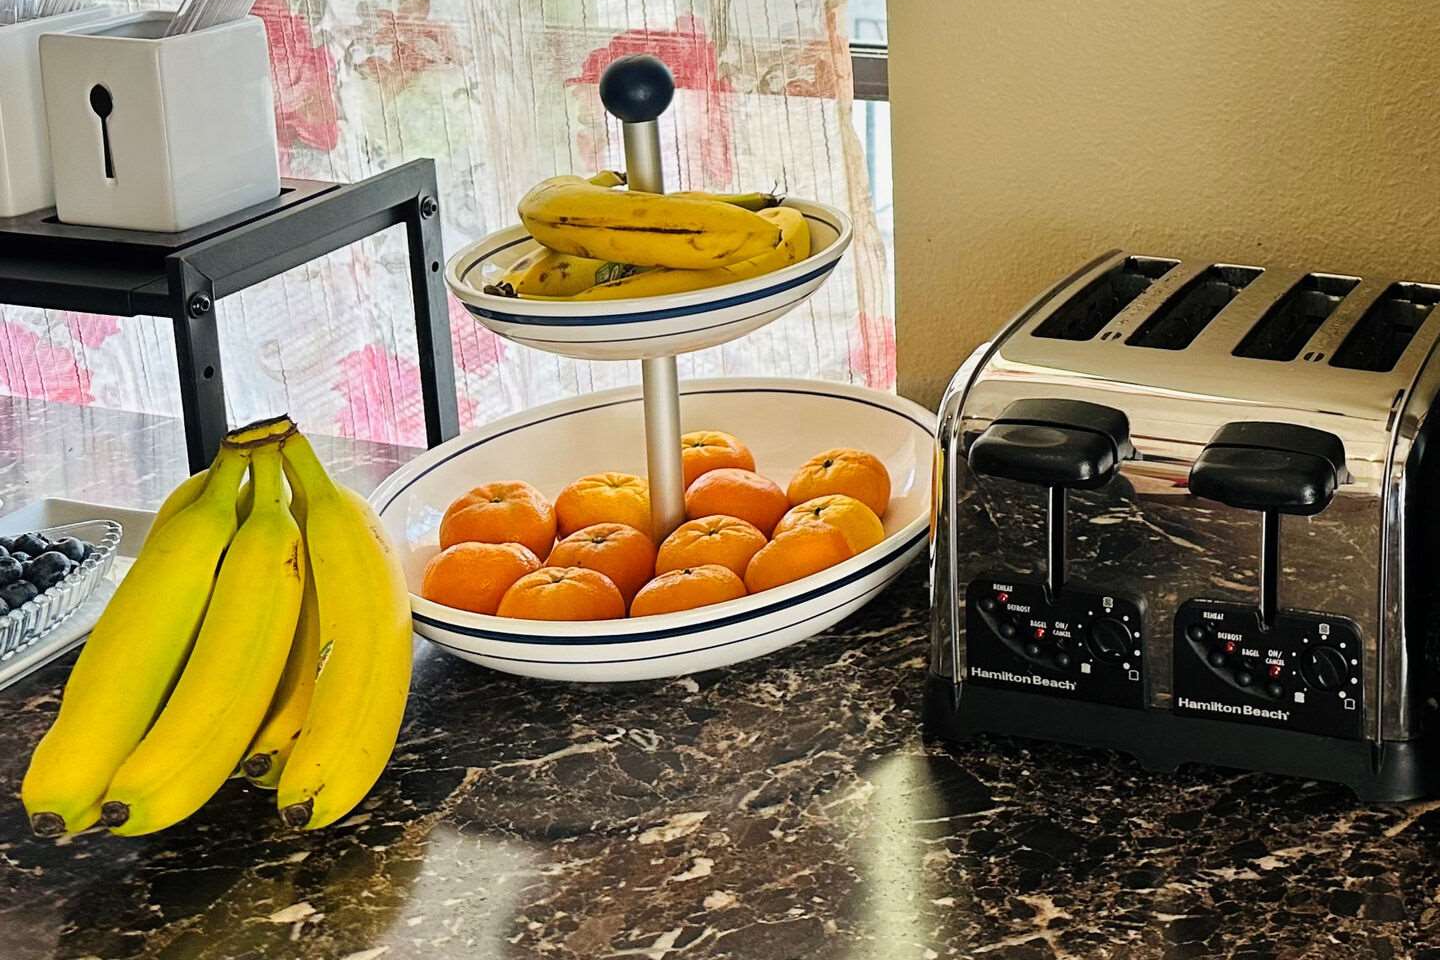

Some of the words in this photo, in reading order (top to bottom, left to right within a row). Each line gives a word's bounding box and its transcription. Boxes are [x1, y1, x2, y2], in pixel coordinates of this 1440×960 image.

[971, 666, 1031, 685] Hamilton
[1032, 674, 1075, 691] Beach
[1178, 696, 1242, 715] Hamilton
[1243, 704, 1286, 721] Beach
